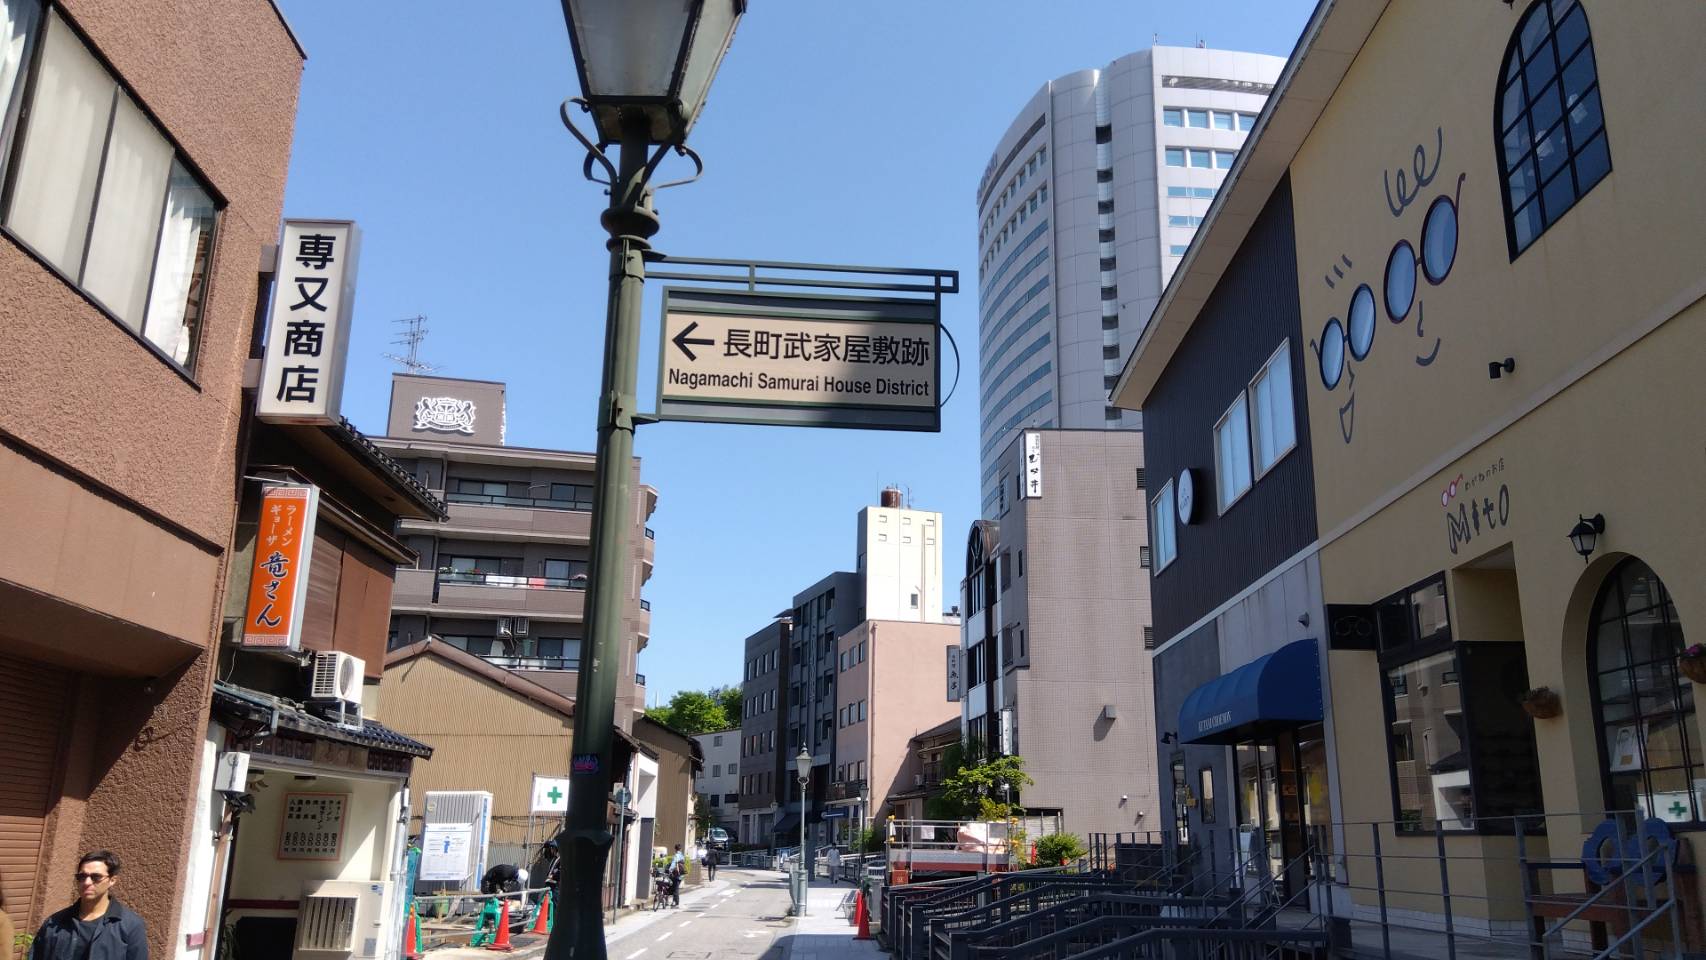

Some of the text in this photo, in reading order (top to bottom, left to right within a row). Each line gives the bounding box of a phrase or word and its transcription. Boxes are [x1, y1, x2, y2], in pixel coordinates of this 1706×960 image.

[276, 233, 336, 403] 専又商店
[723, 328, 930, 366] 長町武家屋敷跡
[668, 368, 929, 396] Nagamachi Samurai House District
[266, 504, 282, 546] ギョーザ
[281, 504, 297, 547] ラーメン
[255, 551, 289, 628] 竜さん
